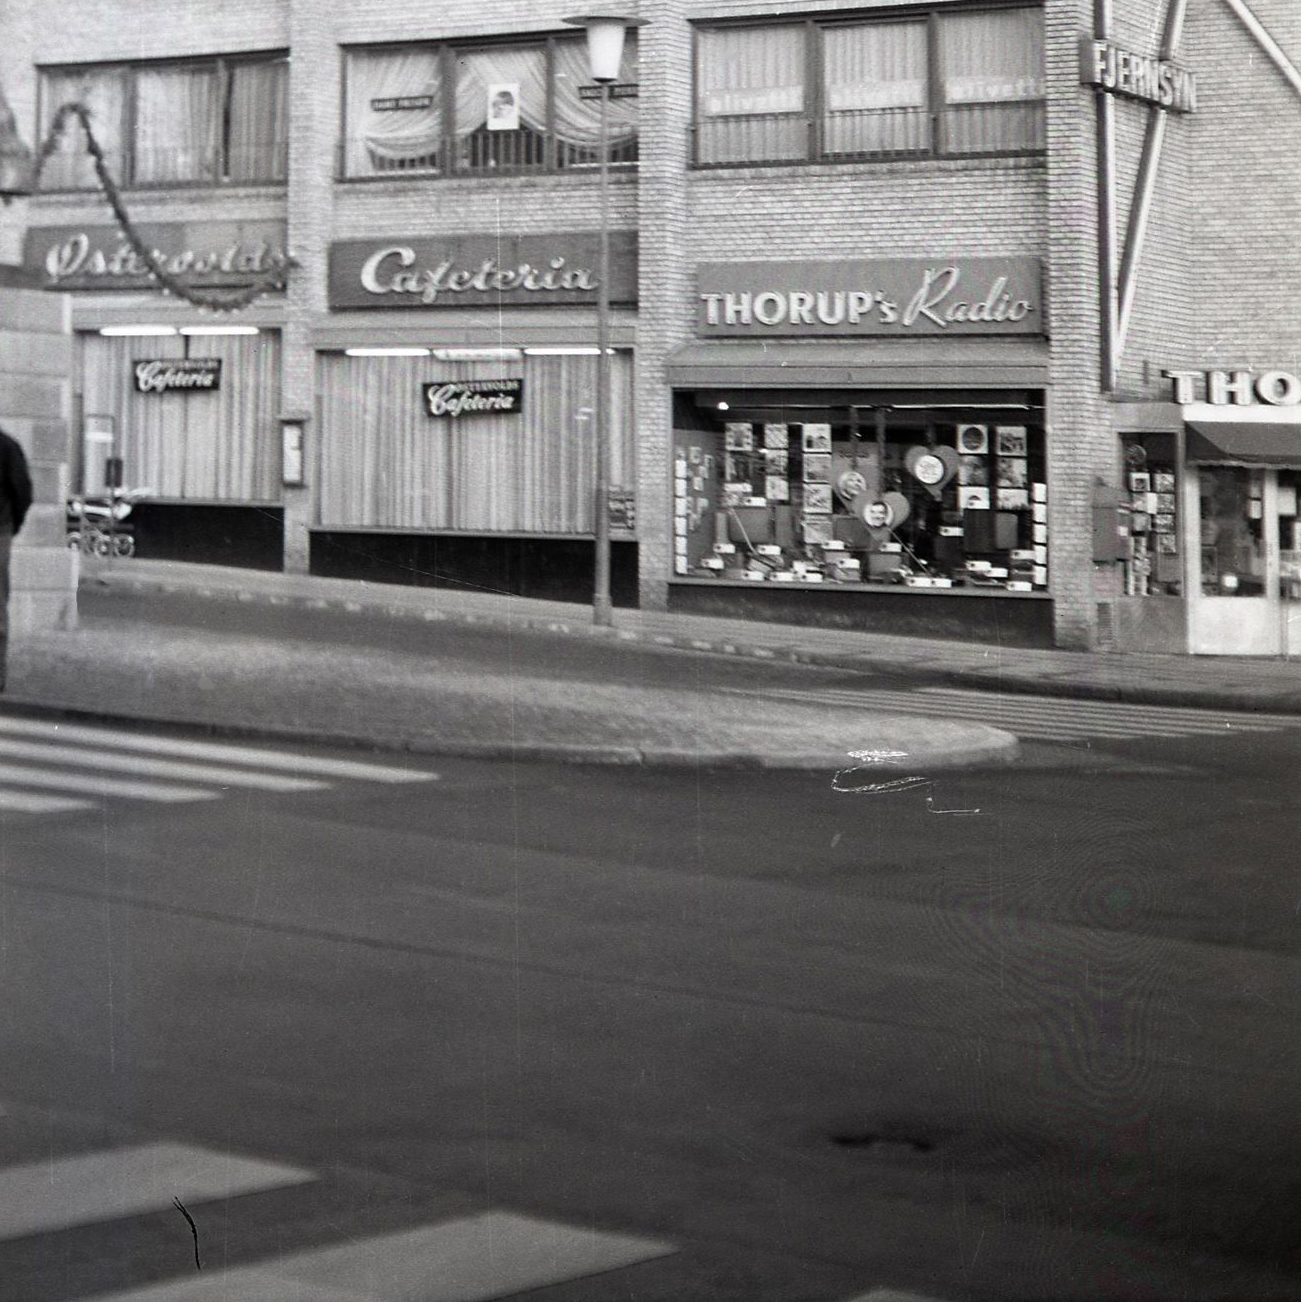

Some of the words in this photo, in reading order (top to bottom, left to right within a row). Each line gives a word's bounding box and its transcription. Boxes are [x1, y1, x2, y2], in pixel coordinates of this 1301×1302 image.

[1094, 42, 1197, 113] FJERNSYN
[361, 247, 598, 303] Cafeteria
[903, 266, 1034, 328] Radio
[428, 384, 515, 417] Cafeteria
